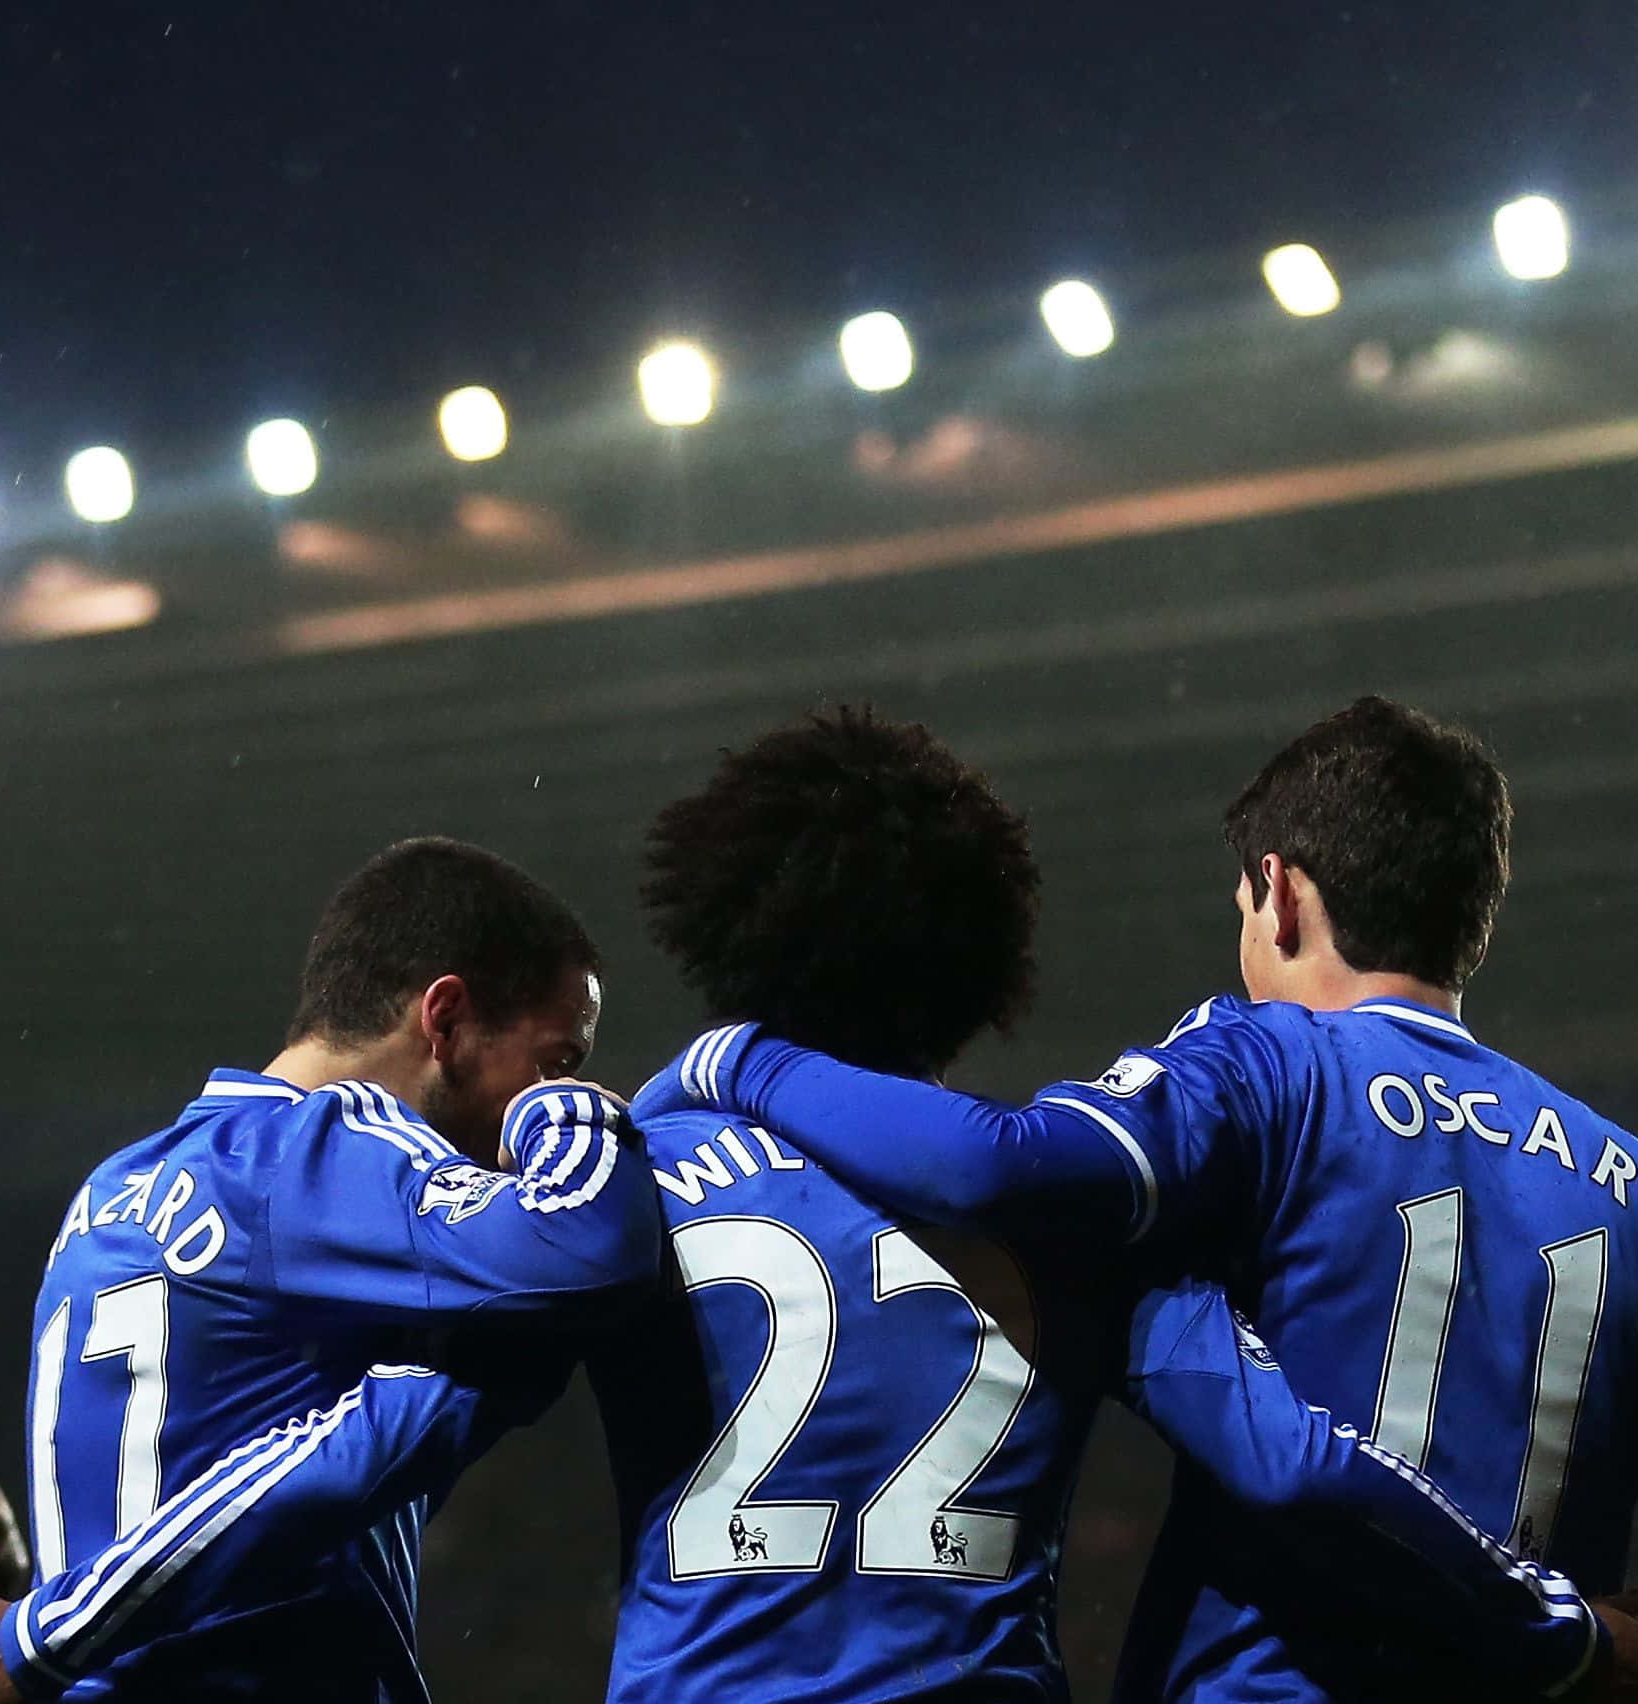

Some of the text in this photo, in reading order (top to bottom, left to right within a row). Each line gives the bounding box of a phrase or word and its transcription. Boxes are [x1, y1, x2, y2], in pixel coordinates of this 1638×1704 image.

[47, 1162, 228, 1275] AZARD
[651, 1124, 824, 1207] WIL
[1367, 1072, 1638, 1207] OSCAR
[33, 1272, 171, 1585] 17
[665, 1213, 1040, 1582] 22
[1370, 1186, 1608, 1562] 11
